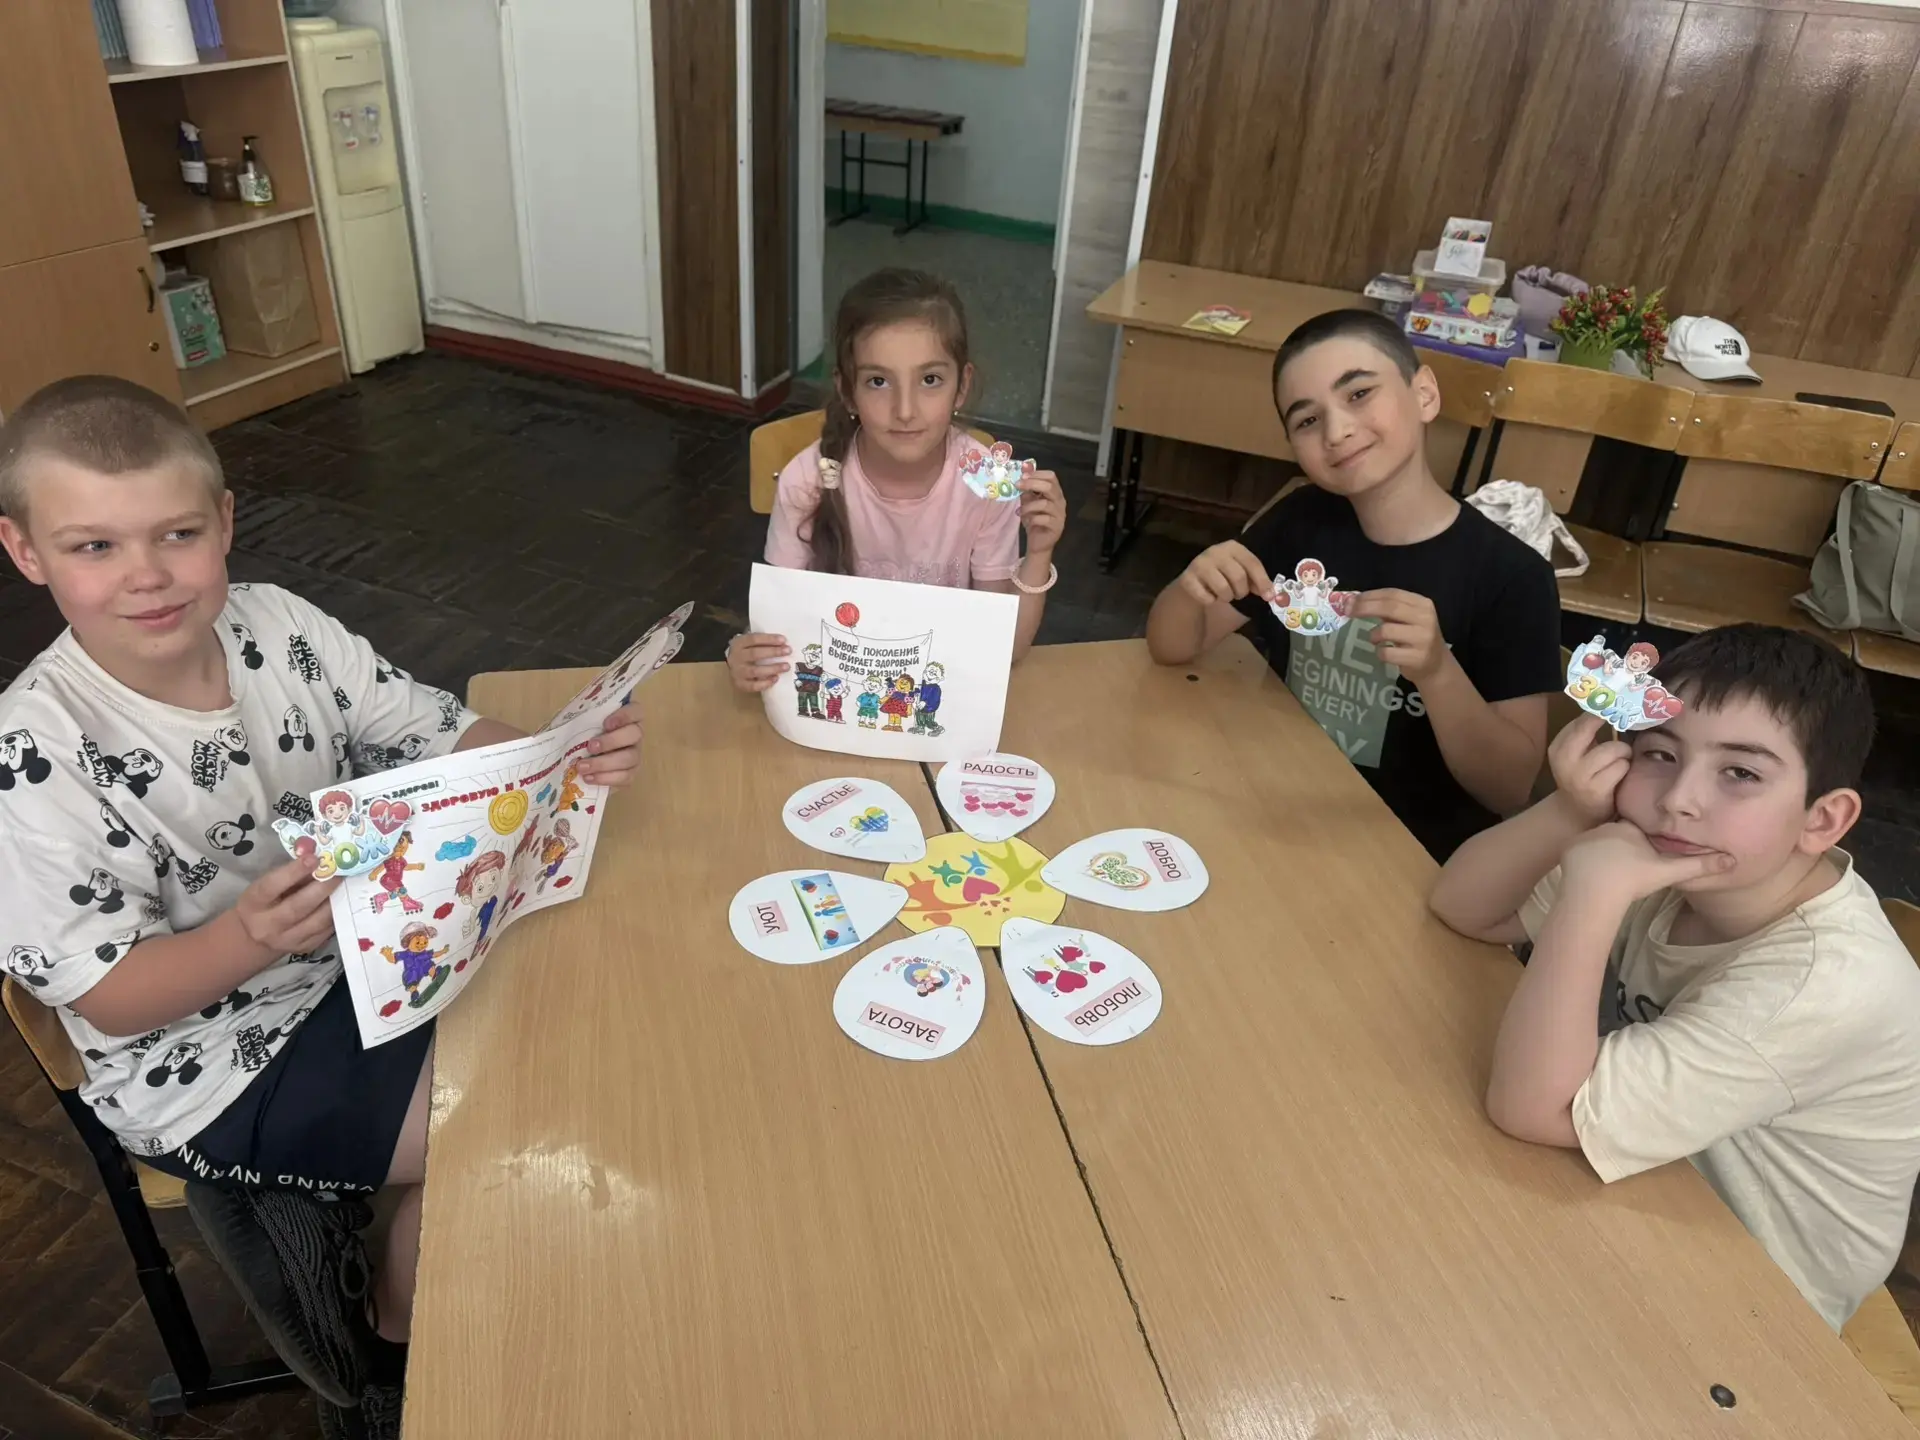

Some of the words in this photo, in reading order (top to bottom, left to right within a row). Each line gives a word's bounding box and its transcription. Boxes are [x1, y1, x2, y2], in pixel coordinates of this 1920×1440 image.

[828, 646, 873, 667] ВЫБИРАЕТ
[875, 655, 919, 668] ЗДОРОВЫЙ
[831, 637, 858, 653] НОВОЕ
[863, 646, 919, 657] ПОКОЛЕНИЕ
[838, 662, 865, 675] ОБРАЗ
[1302, 685, 1369, 725] EVERY
[1568, 675, 1642, 730] ЗОЖ
[191, 740, 207, 787] MOUSE
[203, 740, 223, 792] MICKEY
[964, 762, 1035, 777] РАДОСТЬ
[281, 791, 315, 815] OUSE
[421, 786, 500, 812] ЗДОРОВУЮ
[797, 784, 856, 818] СЧАСТЬЕ
[313, 834, 391, 879] ЗОЖ
[1146, 841, 1182, 879] ДОБРО
[757, 906, 781, 934] УЮТ
[1074, 982, 1141, 1026] ЛЮБОВЬ
[868, 1007, 939, 1043] ЗАБОТА
